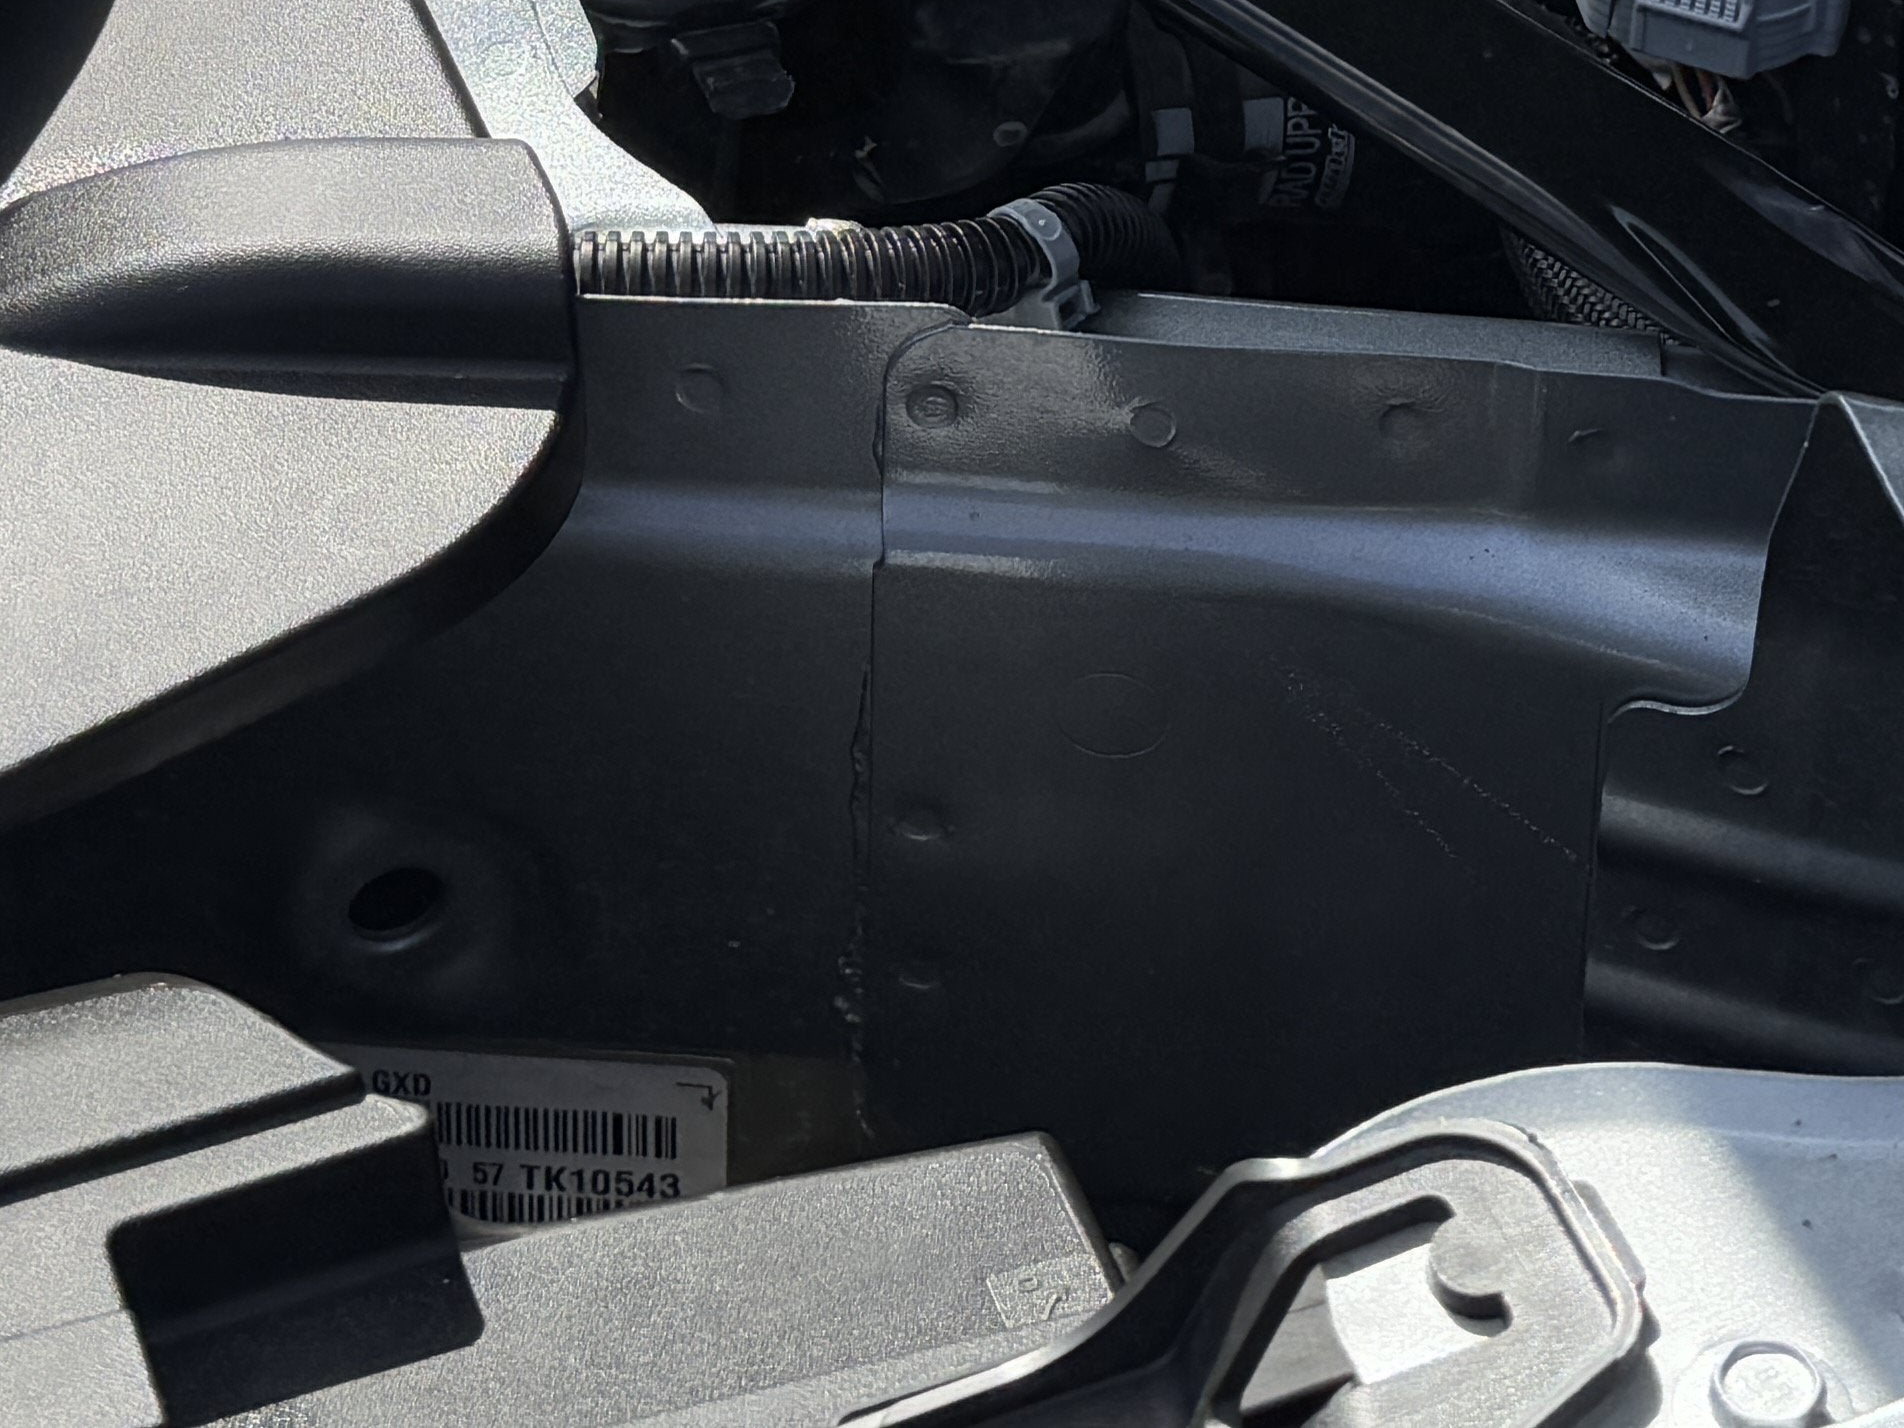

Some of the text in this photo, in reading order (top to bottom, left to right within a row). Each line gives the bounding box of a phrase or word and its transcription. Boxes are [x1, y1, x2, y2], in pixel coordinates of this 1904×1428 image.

[371, 1068, 432, 1097] GXD
[472, 1161, 503, 1187] 57
[519, 1164, 682, 1200] TK10543
